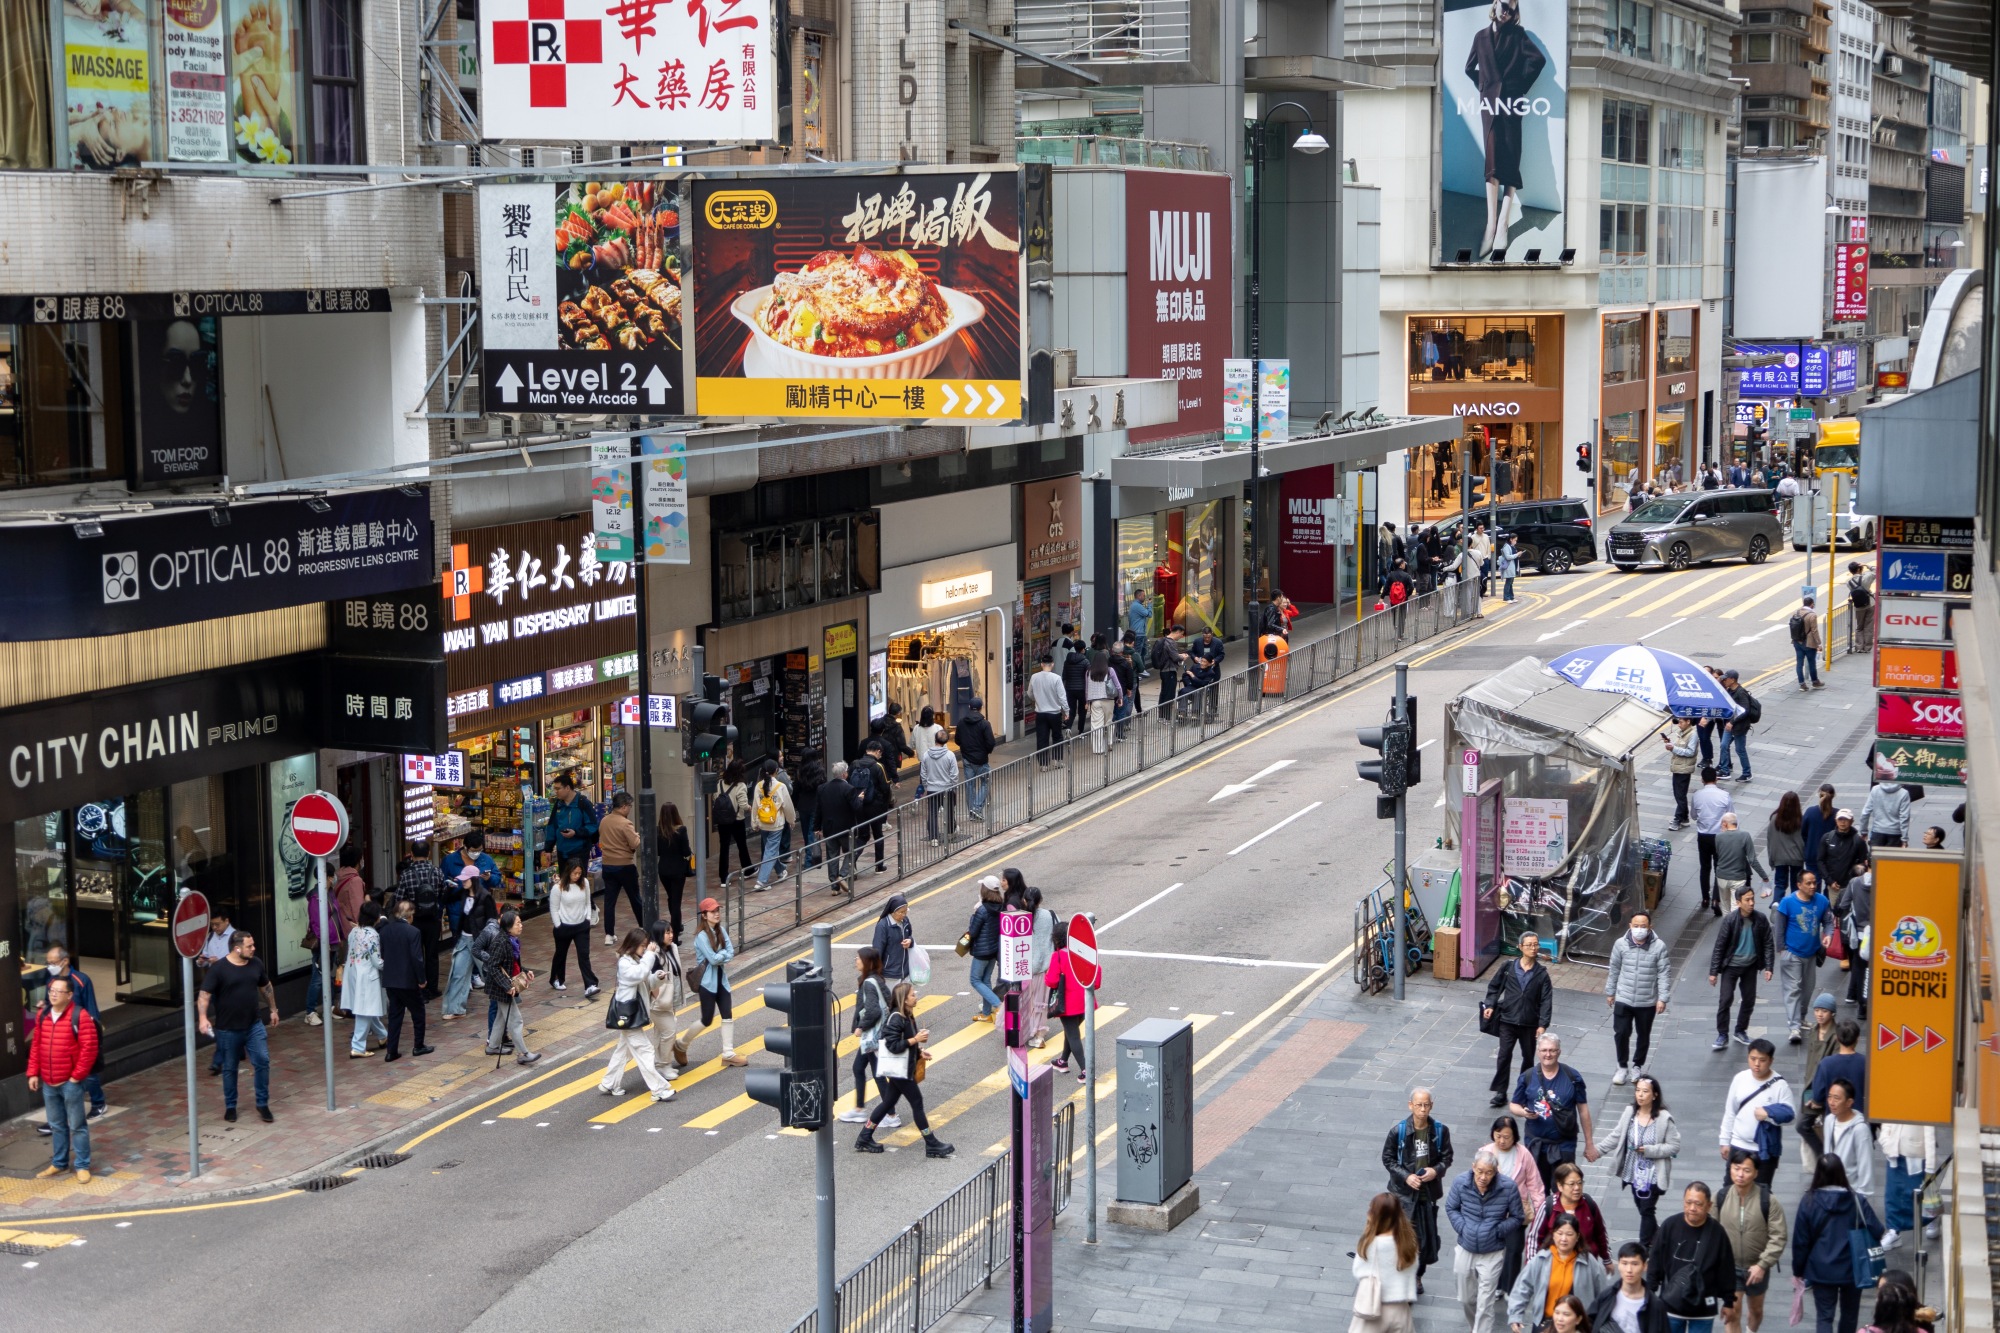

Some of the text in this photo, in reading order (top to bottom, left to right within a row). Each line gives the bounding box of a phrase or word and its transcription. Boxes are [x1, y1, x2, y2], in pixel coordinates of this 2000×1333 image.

[187, 33, 219, 47] Massage
[189, 47, 222, 61] Massage
[71, 54, 144, 81] MASSAGE
[183, 61, 207, 72] Facial
[611, 58, 735, 111] 大藥房
[742, 43, 756, 110] 有限公司
[1457, 97, 1551, 116] MANGO
[179, 108, 224, 125] 35211602
[171, 136, 222, 147] Please Make
[842, 172, 1019, 252] 招牌焗飯
[503, 204, 531, 303] 饗和民
[1150, 210, 1211, 282] MUJI
[194, 293, 263, 313] OPTICAL 88
[1156, 288, 1206, 323] 無印良品
[1162, 342, 1201, 363] 期間限定店
[528, 362, 637, 391] Level 2
[1162, 366, 1203, 380] POP UP Store
[785, 384, 926, 410] 勵精中心一樓
[1671, 382, 1686, 395] MANGO
[529, 391, 637, 405] Man Yee Arcade
[1186, 398, 1197, 409] Level
[1453, 402, 1520, 416] MANGO
[151, 446, 208, 463] TOM FORD
[164, 461, 199, 472] EYEWEAR
[1289, 498, 1325, 515] MUJI
[1292, 515, 1322, 525] 無印良品
[298, 517, 418, 557] 漸進鏡體驗中心
[1049, 522, 1063, 538] CTS
[1905, 535, 1939, 544] FOOT
[150, 538, 291, 590] OPTICAL 88
[298, 549, 419, 576] PROGRESSIVE LENS CENTRE
[1901, 569, 1941, 581] Shibata
[443, 626, 475, 652] WAH
[480, 619, 508, 644] YAN
[513, 602, 592, 638] DISPENSARY
[1885, 614, 1938, 627] GNC
[1886, 672, 1936, 683] mannings
[499, 675, 543, 703] 中西醫藥
[346, 693, 413, 720] 時間廊
[447, 688, 489, 717] 生活百貨
[649, 697, 672, 710] 配藥
[649, 710, 672, 723] 服務
[10, 711, 278, 788] CITY CHAIN PRIMO
[434, 754, 460, 768] 配藥
[435, 768, 460, 782] 服務
[1915, 771, 1937, 779] Seafood
[1015, 940, 1030, 976] 中環
[1882, 969, 1940, 983] DON DON
